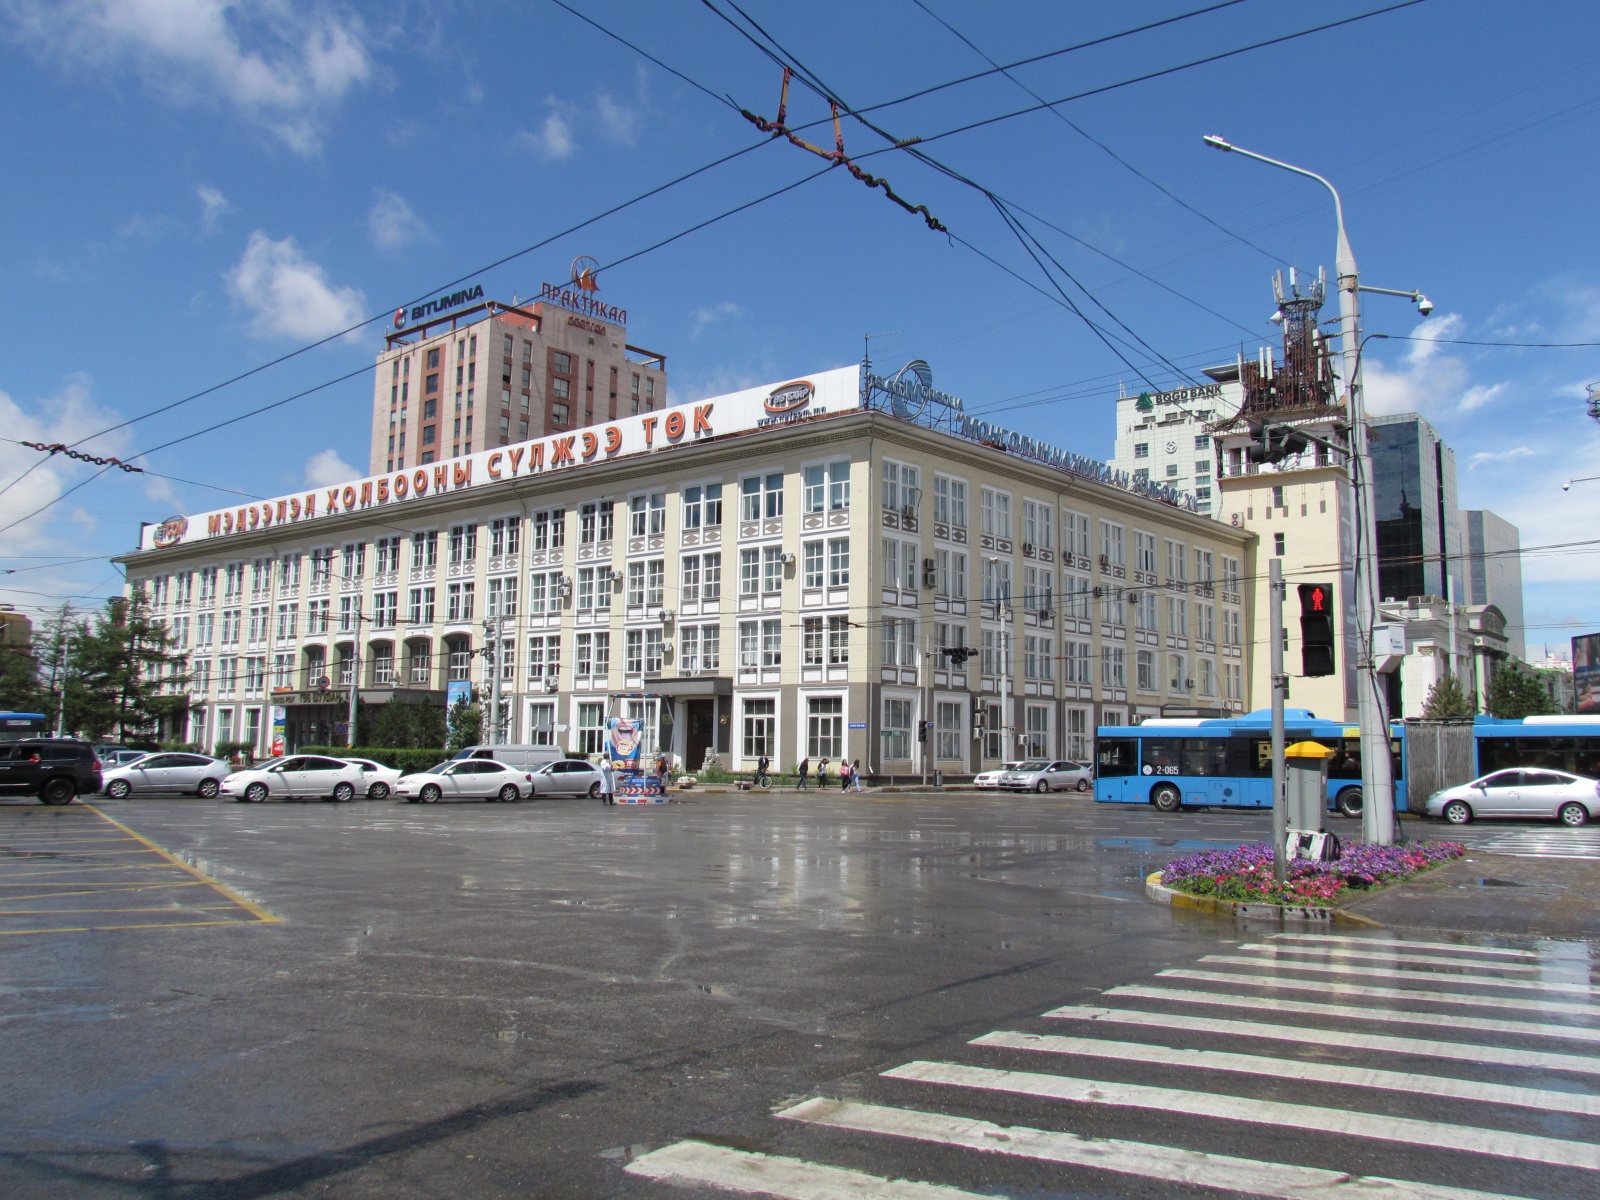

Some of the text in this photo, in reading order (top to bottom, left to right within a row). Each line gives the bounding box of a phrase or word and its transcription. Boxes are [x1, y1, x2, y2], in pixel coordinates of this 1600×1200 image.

[412, 285, 484, 320] BITUMINA
[541, 282, 627, 324] ПРАКТИКАЛ
[1156, 385, 1222, 403] BOGD BANK
[207, 403, 713, 534] МЭДЭЭЛЭЛ ХОЛБООНЫ СҮЛЖЭЭ ТӨК
[1156, 765, 1179, 775] 2-065
